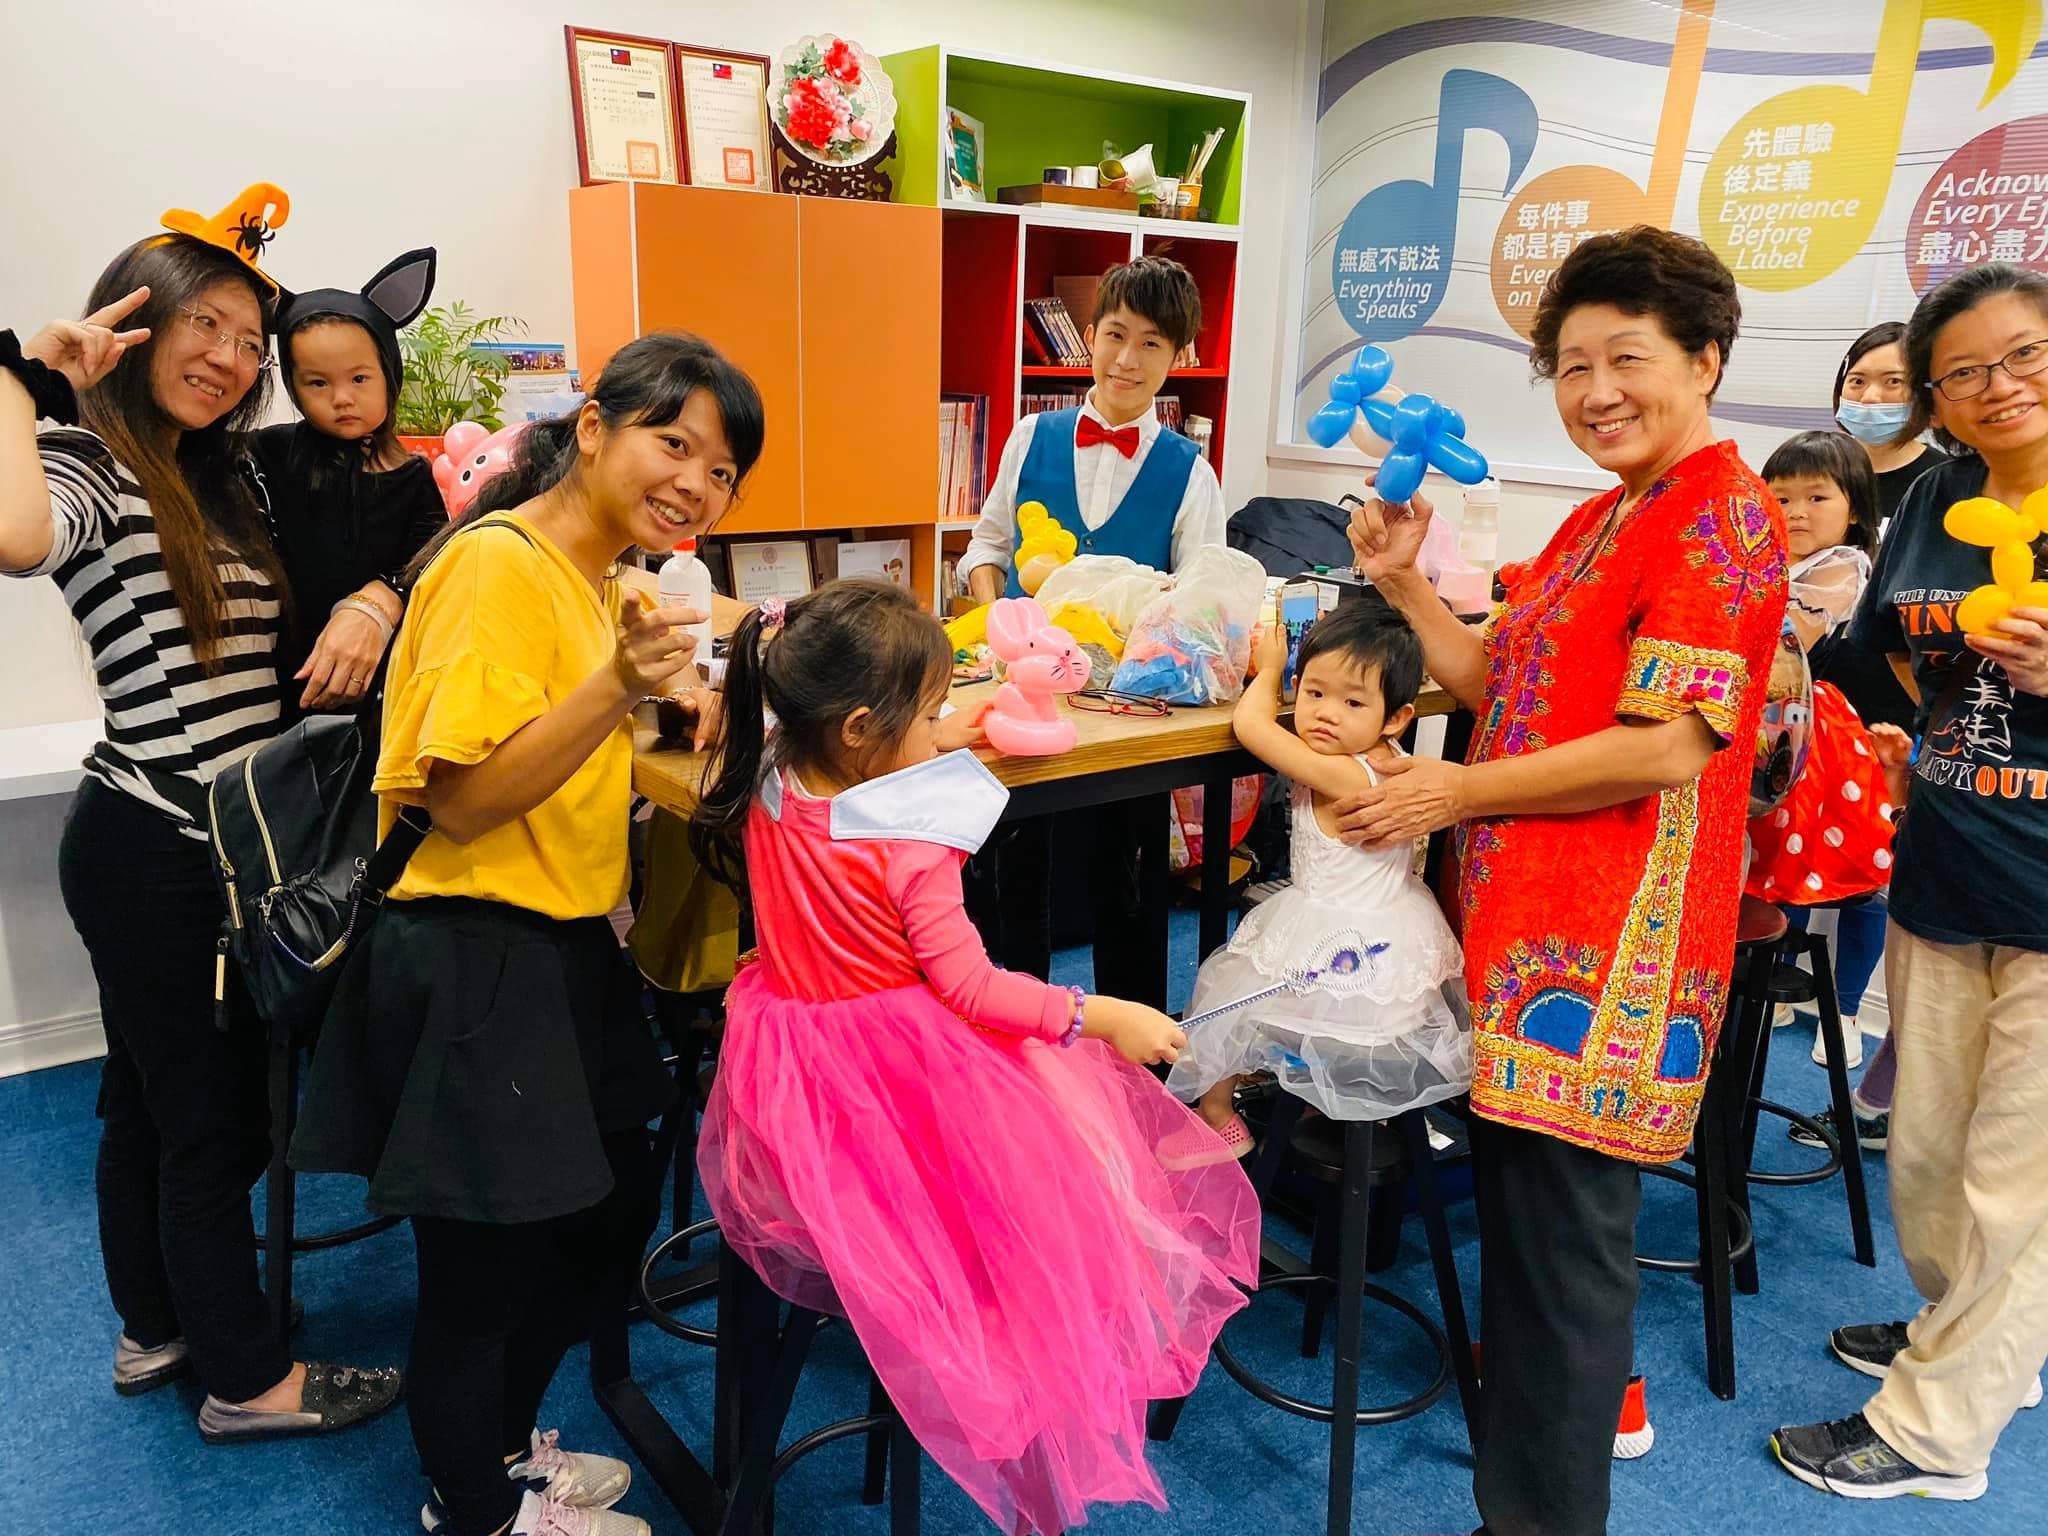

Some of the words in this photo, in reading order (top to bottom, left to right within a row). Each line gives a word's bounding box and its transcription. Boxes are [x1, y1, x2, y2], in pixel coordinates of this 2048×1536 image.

[1741, 122, 1836, 159] 先體驗
[1723, 160, 1813, 196] 後定義
[1517, 199, 1590, 230] 每件事
[1718, 195, 1860, 228] Experience
[1922, 199, 2015, 232] Every
[1728, 221, 1812, 252] Before
[1735, 245, 1808, 270] Label
[1339, 277, 1432, 305] Everything
[1507, 290, 1532, 306] on
[1356, 298, 1417, 324] Speaks
